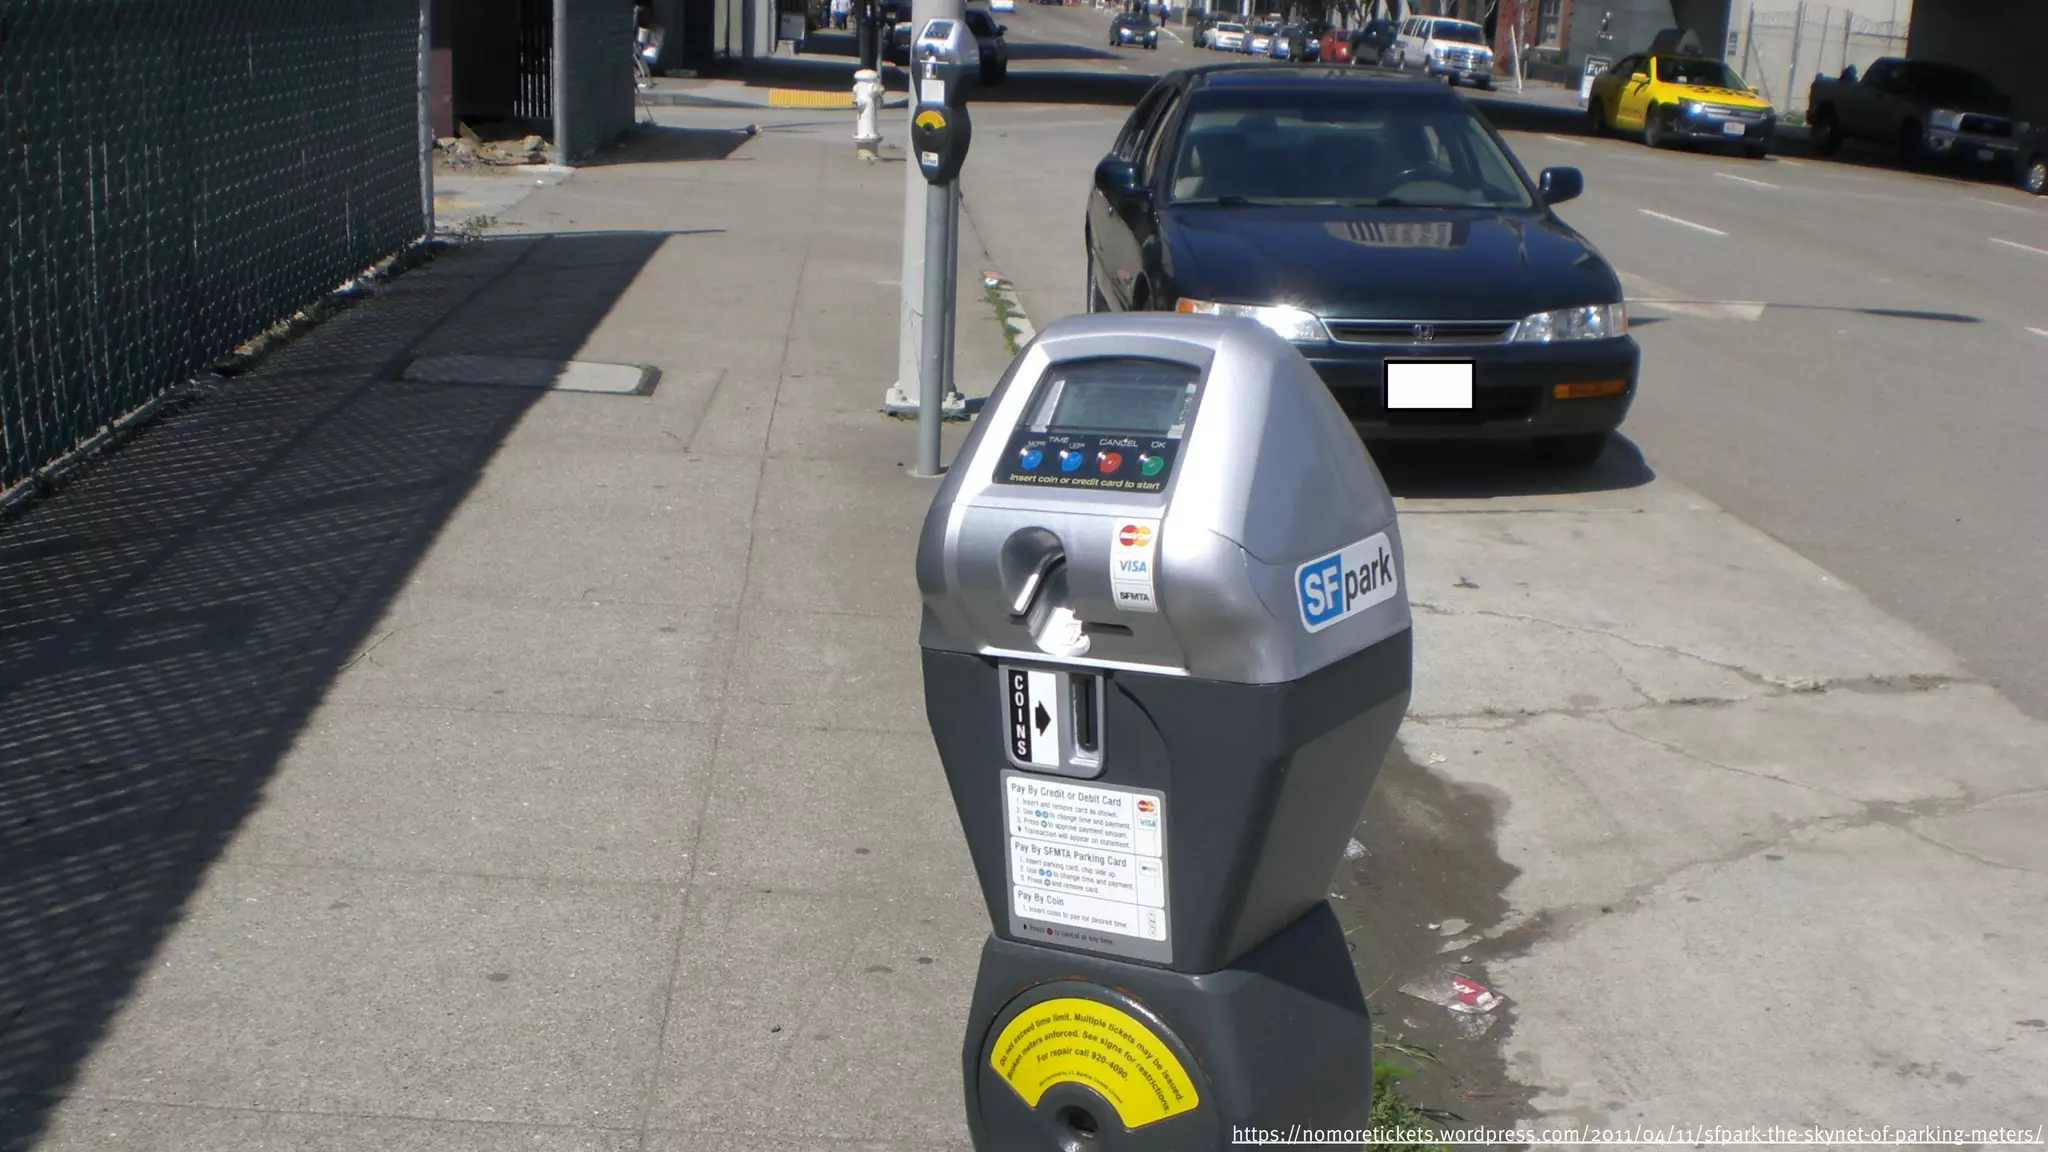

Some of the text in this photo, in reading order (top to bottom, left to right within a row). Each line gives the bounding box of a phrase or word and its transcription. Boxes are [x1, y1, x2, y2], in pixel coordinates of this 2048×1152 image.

[1048, 436, 1070, 444] TIME
[1100, 438, 1138, 448] CANCEL
[1010, 474, 1037, 483] Insert
[1038, 476, 1059, 484] coin
[1072, 477, 1098, 486] credit
[1100, 479, 1123, 488] card
[1136, 481, 1160, 490] start
[1120, 560, 1147, 572] VISA
[1120, 592, 1150, 602] SFMTA
[1014, 675, 1026, 756] COINS
[1012, 783, 1122, 806] Pay By Credit or Debit Card
[1023, 798, 1039, 806] Insert
[1052, 804, 1073, 812] remove
[1075, 806, 1088, 814] card
[1024, 818, 1039, 826] Press
[1057, 813, 1077, 822] change
[1079, 816, 1091, 824] time
[1140, 819, 1156, 827] VISA
[1024, 826, 1056, 837] Transaction
[1015, 842, 1126, 867] Pay By SFMTA Parking Card
[1052, 880, 1062, 888] and
[1018, 891, 1064, 906] Pay By Coin
[1000, 1013, 1184, 1103] Do not exceed time limit. Multiple tickets may be issued.
[1037, 1048, 1128, 1082] For repair call 920-4090.
[1007, 1054, 1022, 1080] Broken
[1022, 1037, 1043, 1056] meters
[1044, 1030, 1080, 1041] enforced.
[1082, 1030, 1098, 1042] See
[1100, 1038, 1122, 1054] signs
[1124, 1051, 1136, 1064] for
[1136, 1064, 1170, 1114] restrictions.
